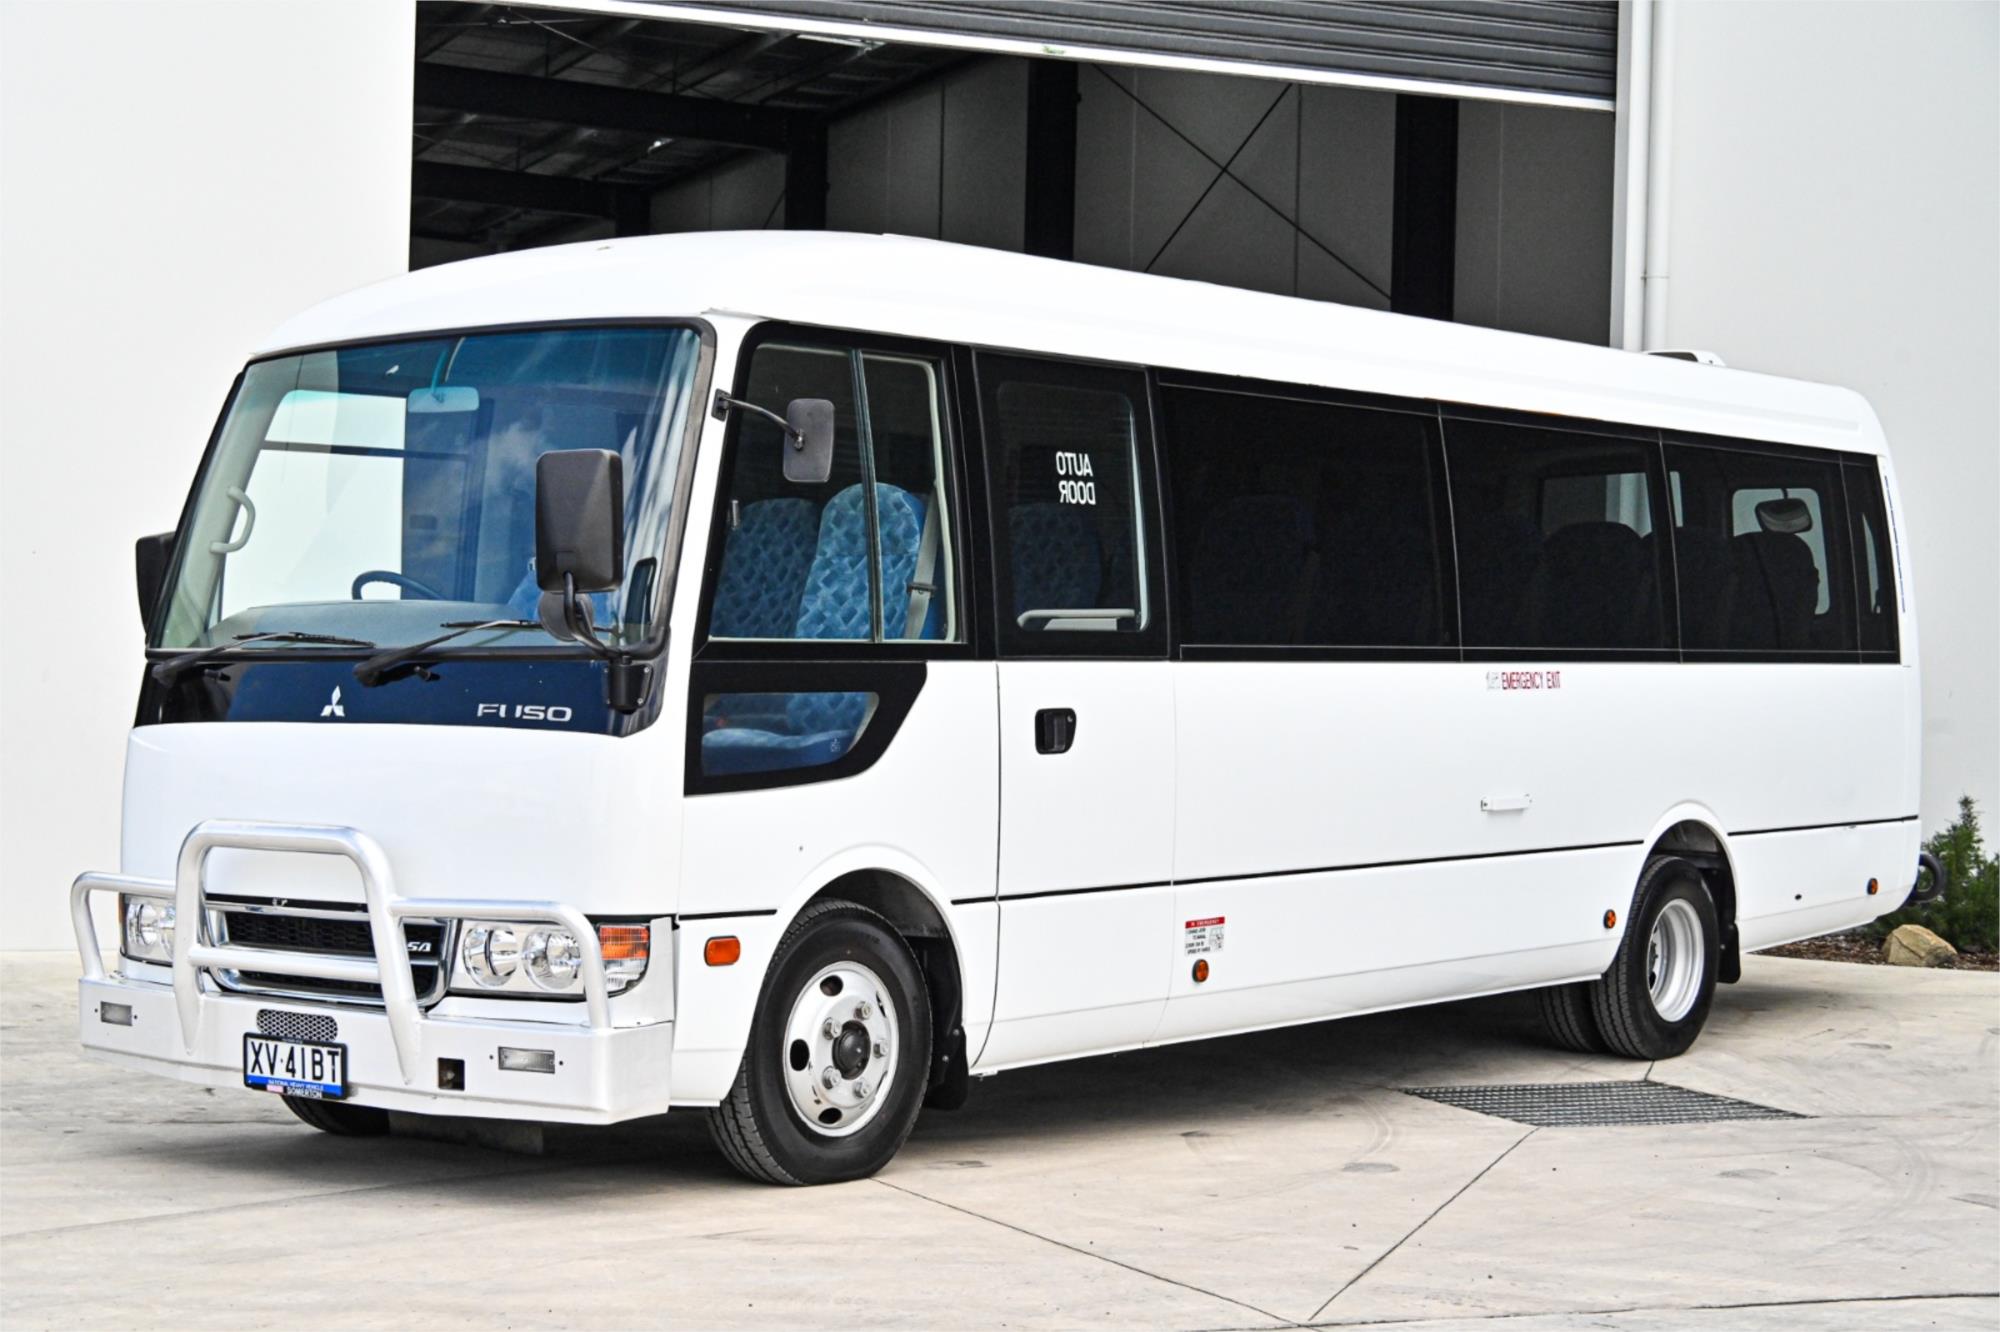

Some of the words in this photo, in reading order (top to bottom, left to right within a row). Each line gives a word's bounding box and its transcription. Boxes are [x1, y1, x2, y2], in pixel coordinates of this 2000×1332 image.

[1501, 671, 1543, 690] EMERGENCY
[1546, 671, 1561, 690] EXIT
[476, 703, 573, 722] FUSO
[407, 941, 432, 952] SA
